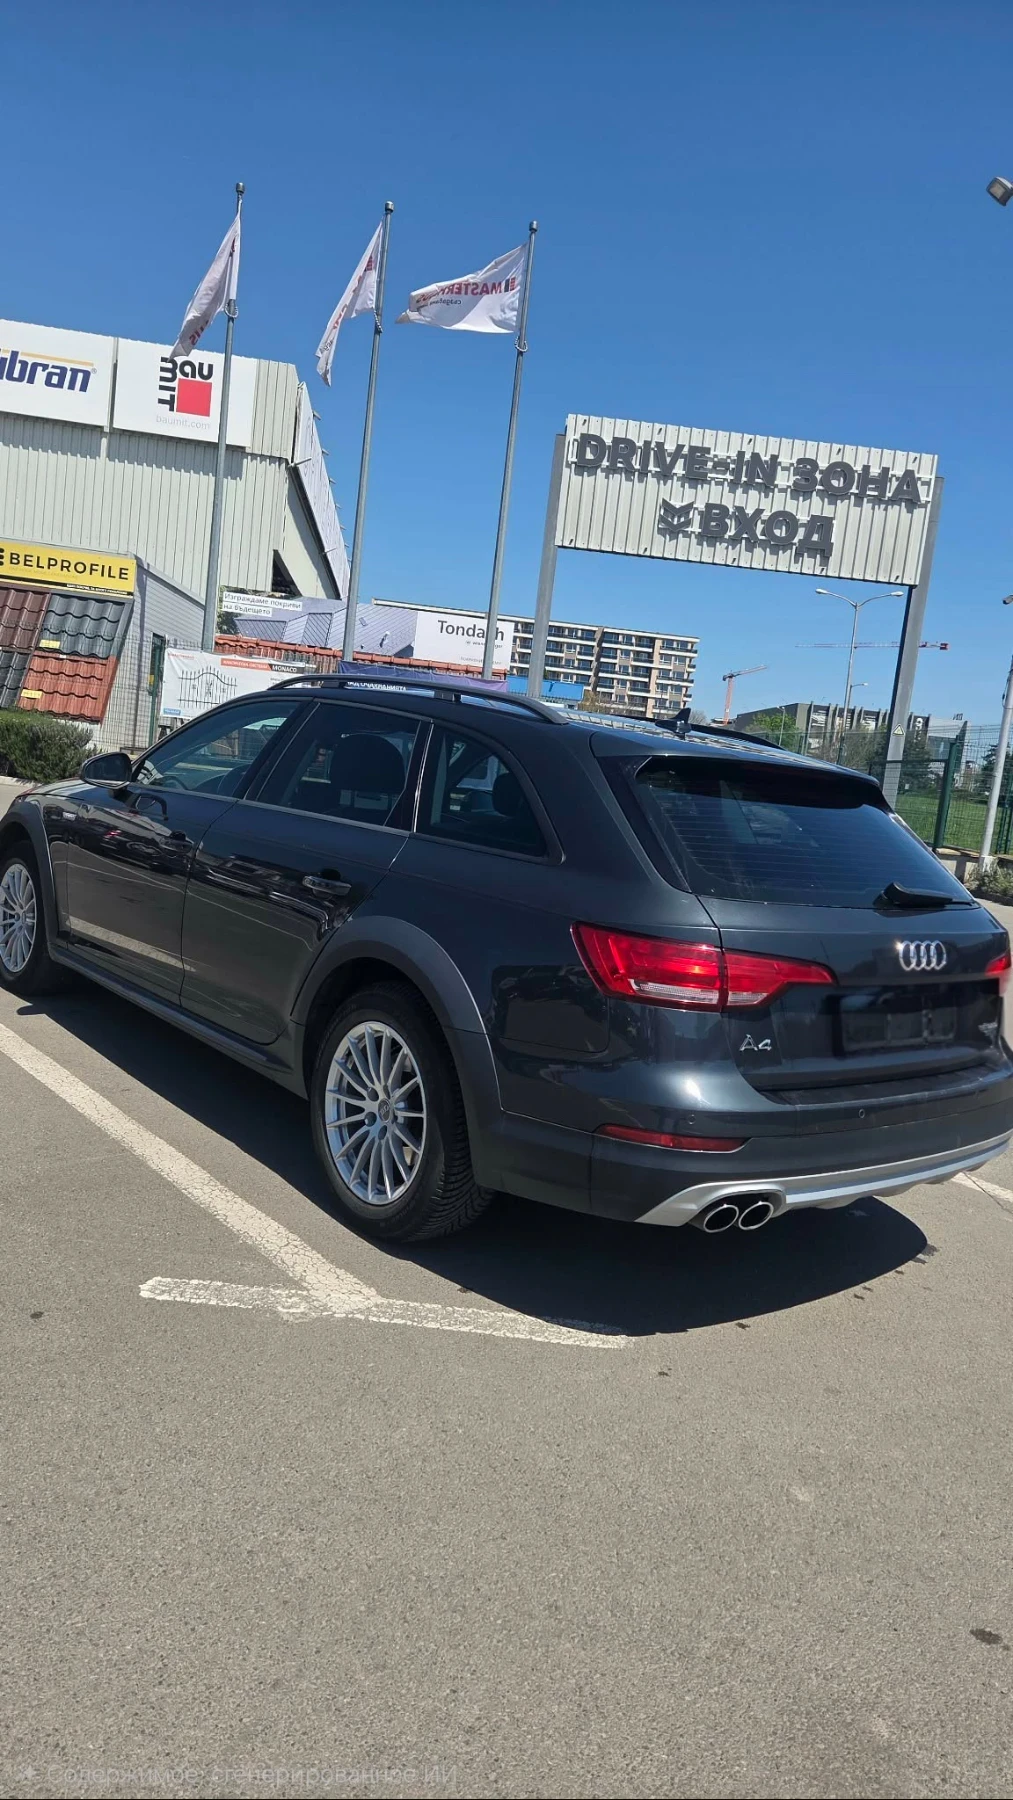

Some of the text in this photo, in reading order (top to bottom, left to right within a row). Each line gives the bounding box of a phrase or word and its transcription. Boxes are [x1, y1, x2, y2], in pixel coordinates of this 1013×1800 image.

[156, 415, 210, 430] baumit.com
[577, 432, 923, 502] DRIVE-IN ЗОНА
[701, 502, 835, 558] ВХОД
[9, 552, 129, 581] BELPROFILE
[224, 593, 301, 610] Изграждаме покриви
[234, 604, 271, 615] бъдещето
[438, 620, 504, 641] Tondah
[272, 665, 298, 673] MONACO
[739, 1033, 772, 1052] A4
